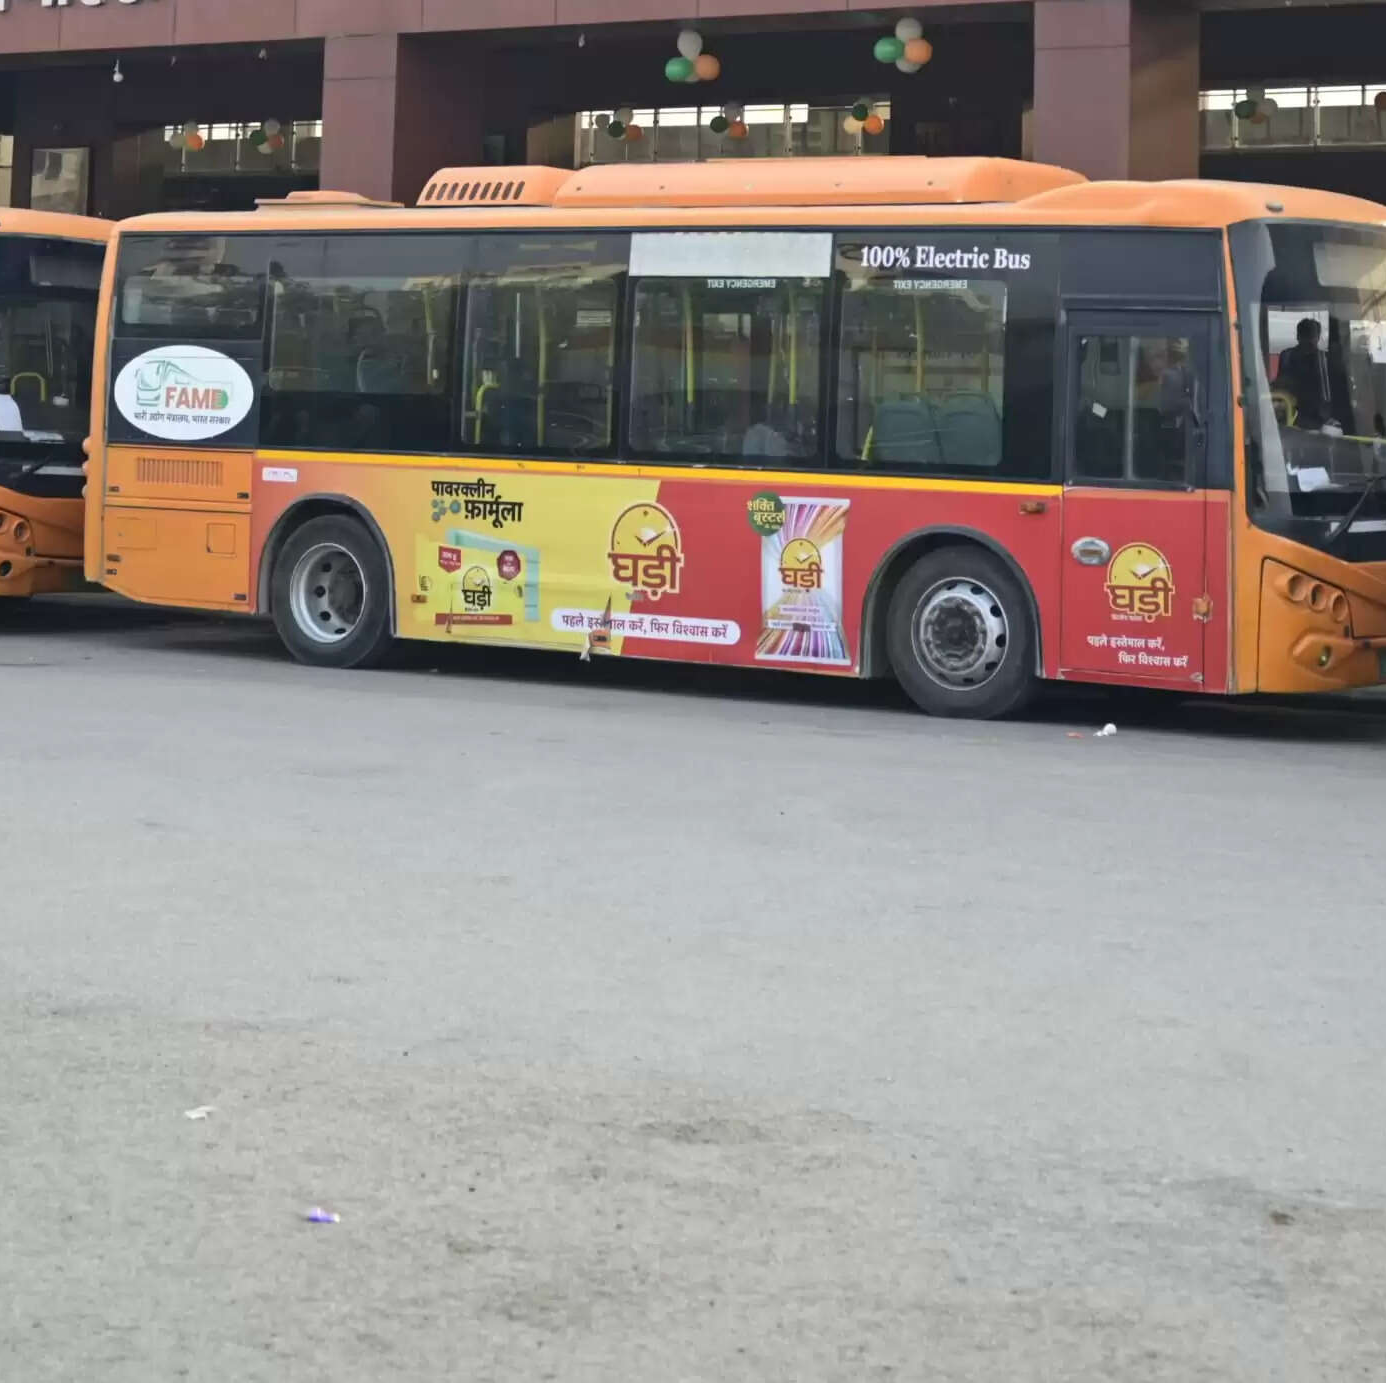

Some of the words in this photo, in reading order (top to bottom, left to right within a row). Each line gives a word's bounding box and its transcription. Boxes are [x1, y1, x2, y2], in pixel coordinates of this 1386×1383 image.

[860, 245, 911, 268] 100%
[914, 245, 990, 269] Electric
[992, 248, 1031, 270] Bus
[164, 386, 229, 411] FAME
[431, 478, 496, 498] पावरक्लीन
[607, 543, 684, 601] घड़ी
[778, 561, 824, 593] घड़ी
[461, 585, 492, 611] घड़ी
[1103, 577, 1175, 623] घड़ी
[561, 613, 584, 628] पहले
[650, 619, 669, 634] फिर
[672, 619, 709, 638] विश्वास
[711, 623, 729, 639] करें
[1087, 633, 1108, 647] पहले
[1118, 650, 1136, 665] फिर
